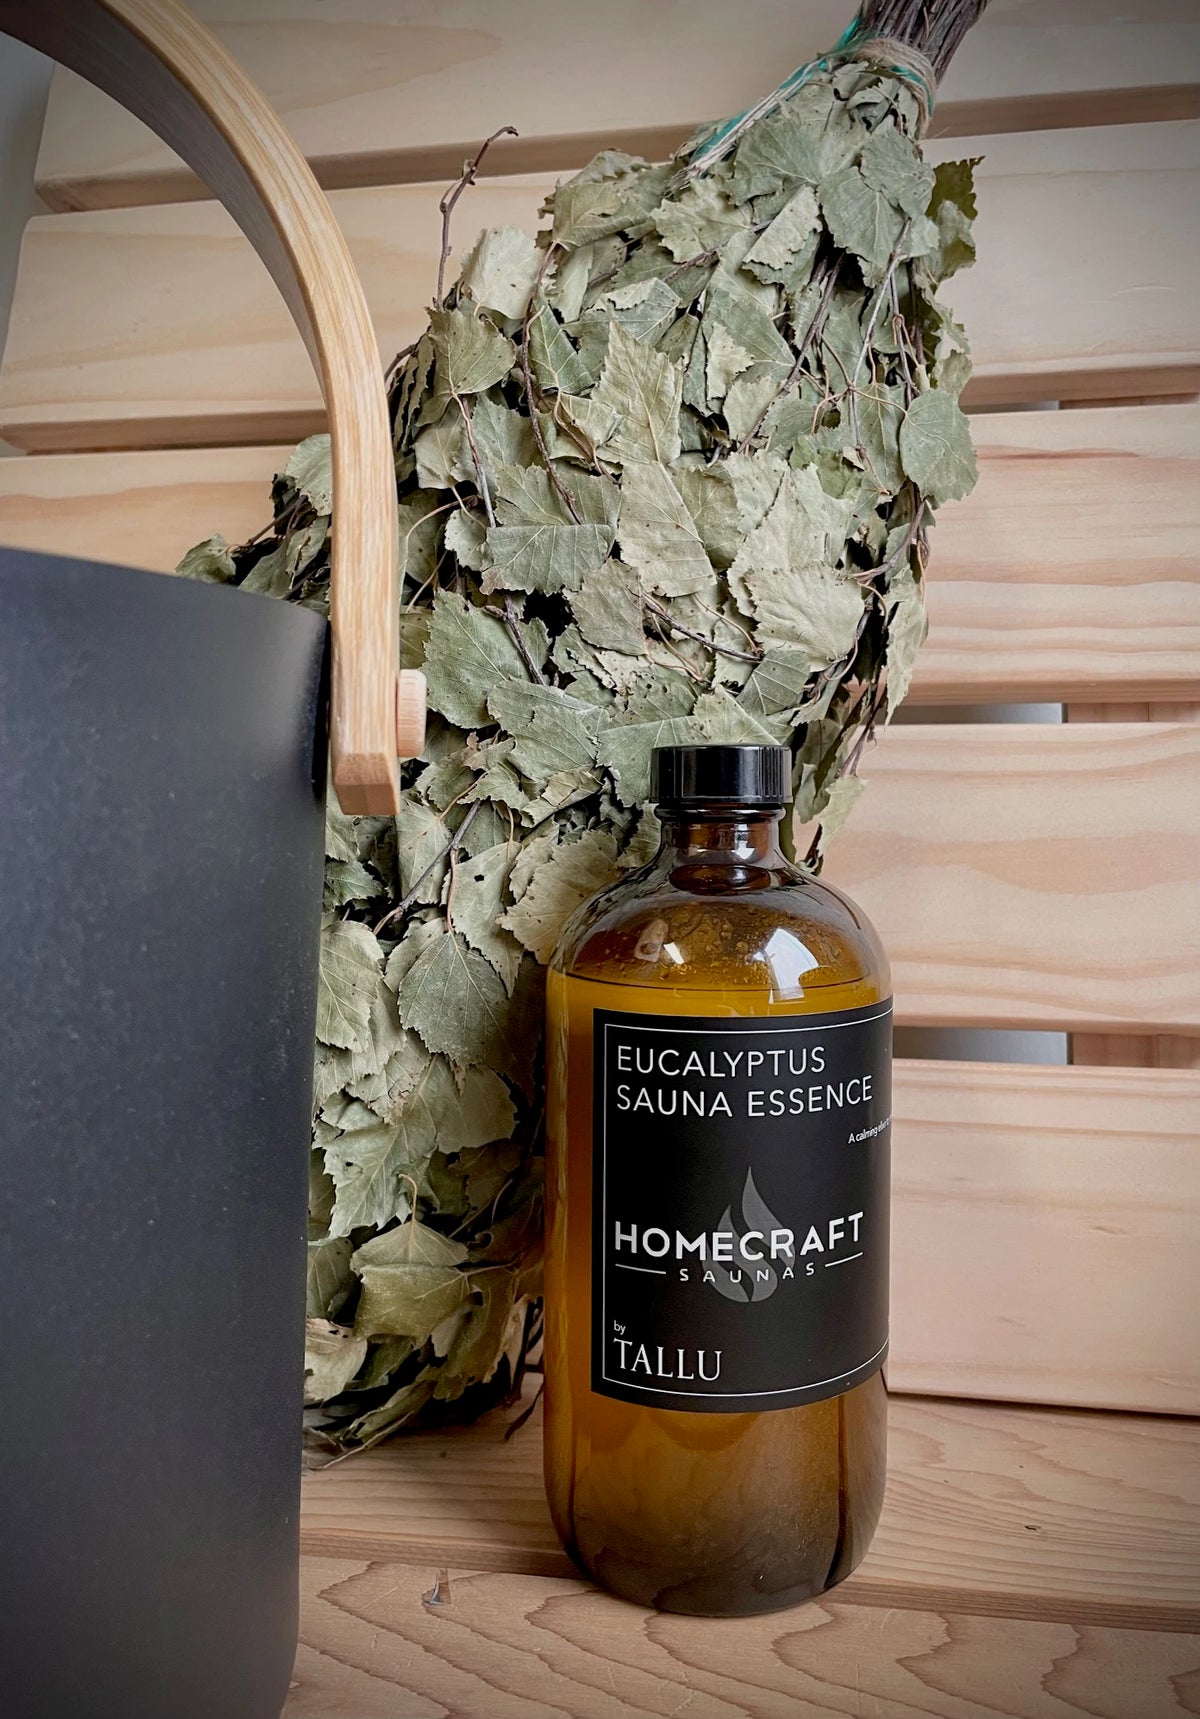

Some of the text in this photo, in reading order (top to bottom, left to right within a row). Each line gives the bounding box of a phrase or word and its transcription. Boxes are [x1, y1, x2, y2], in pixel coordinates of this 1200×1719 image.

[617, 1045, 826, 1078] EUCALYPTUS
[616, 1075, 873, 1117] SAUNA ESSENCE
[848, 1127, 878, 1144] A calming
[614, 1211, 864, 1262] HOMECRAFT
[678, 1261, 816, 1283] SAUNAS
[613, 1319, 627, 1335] by
[613, 1337, 723, 1382] TALLU
